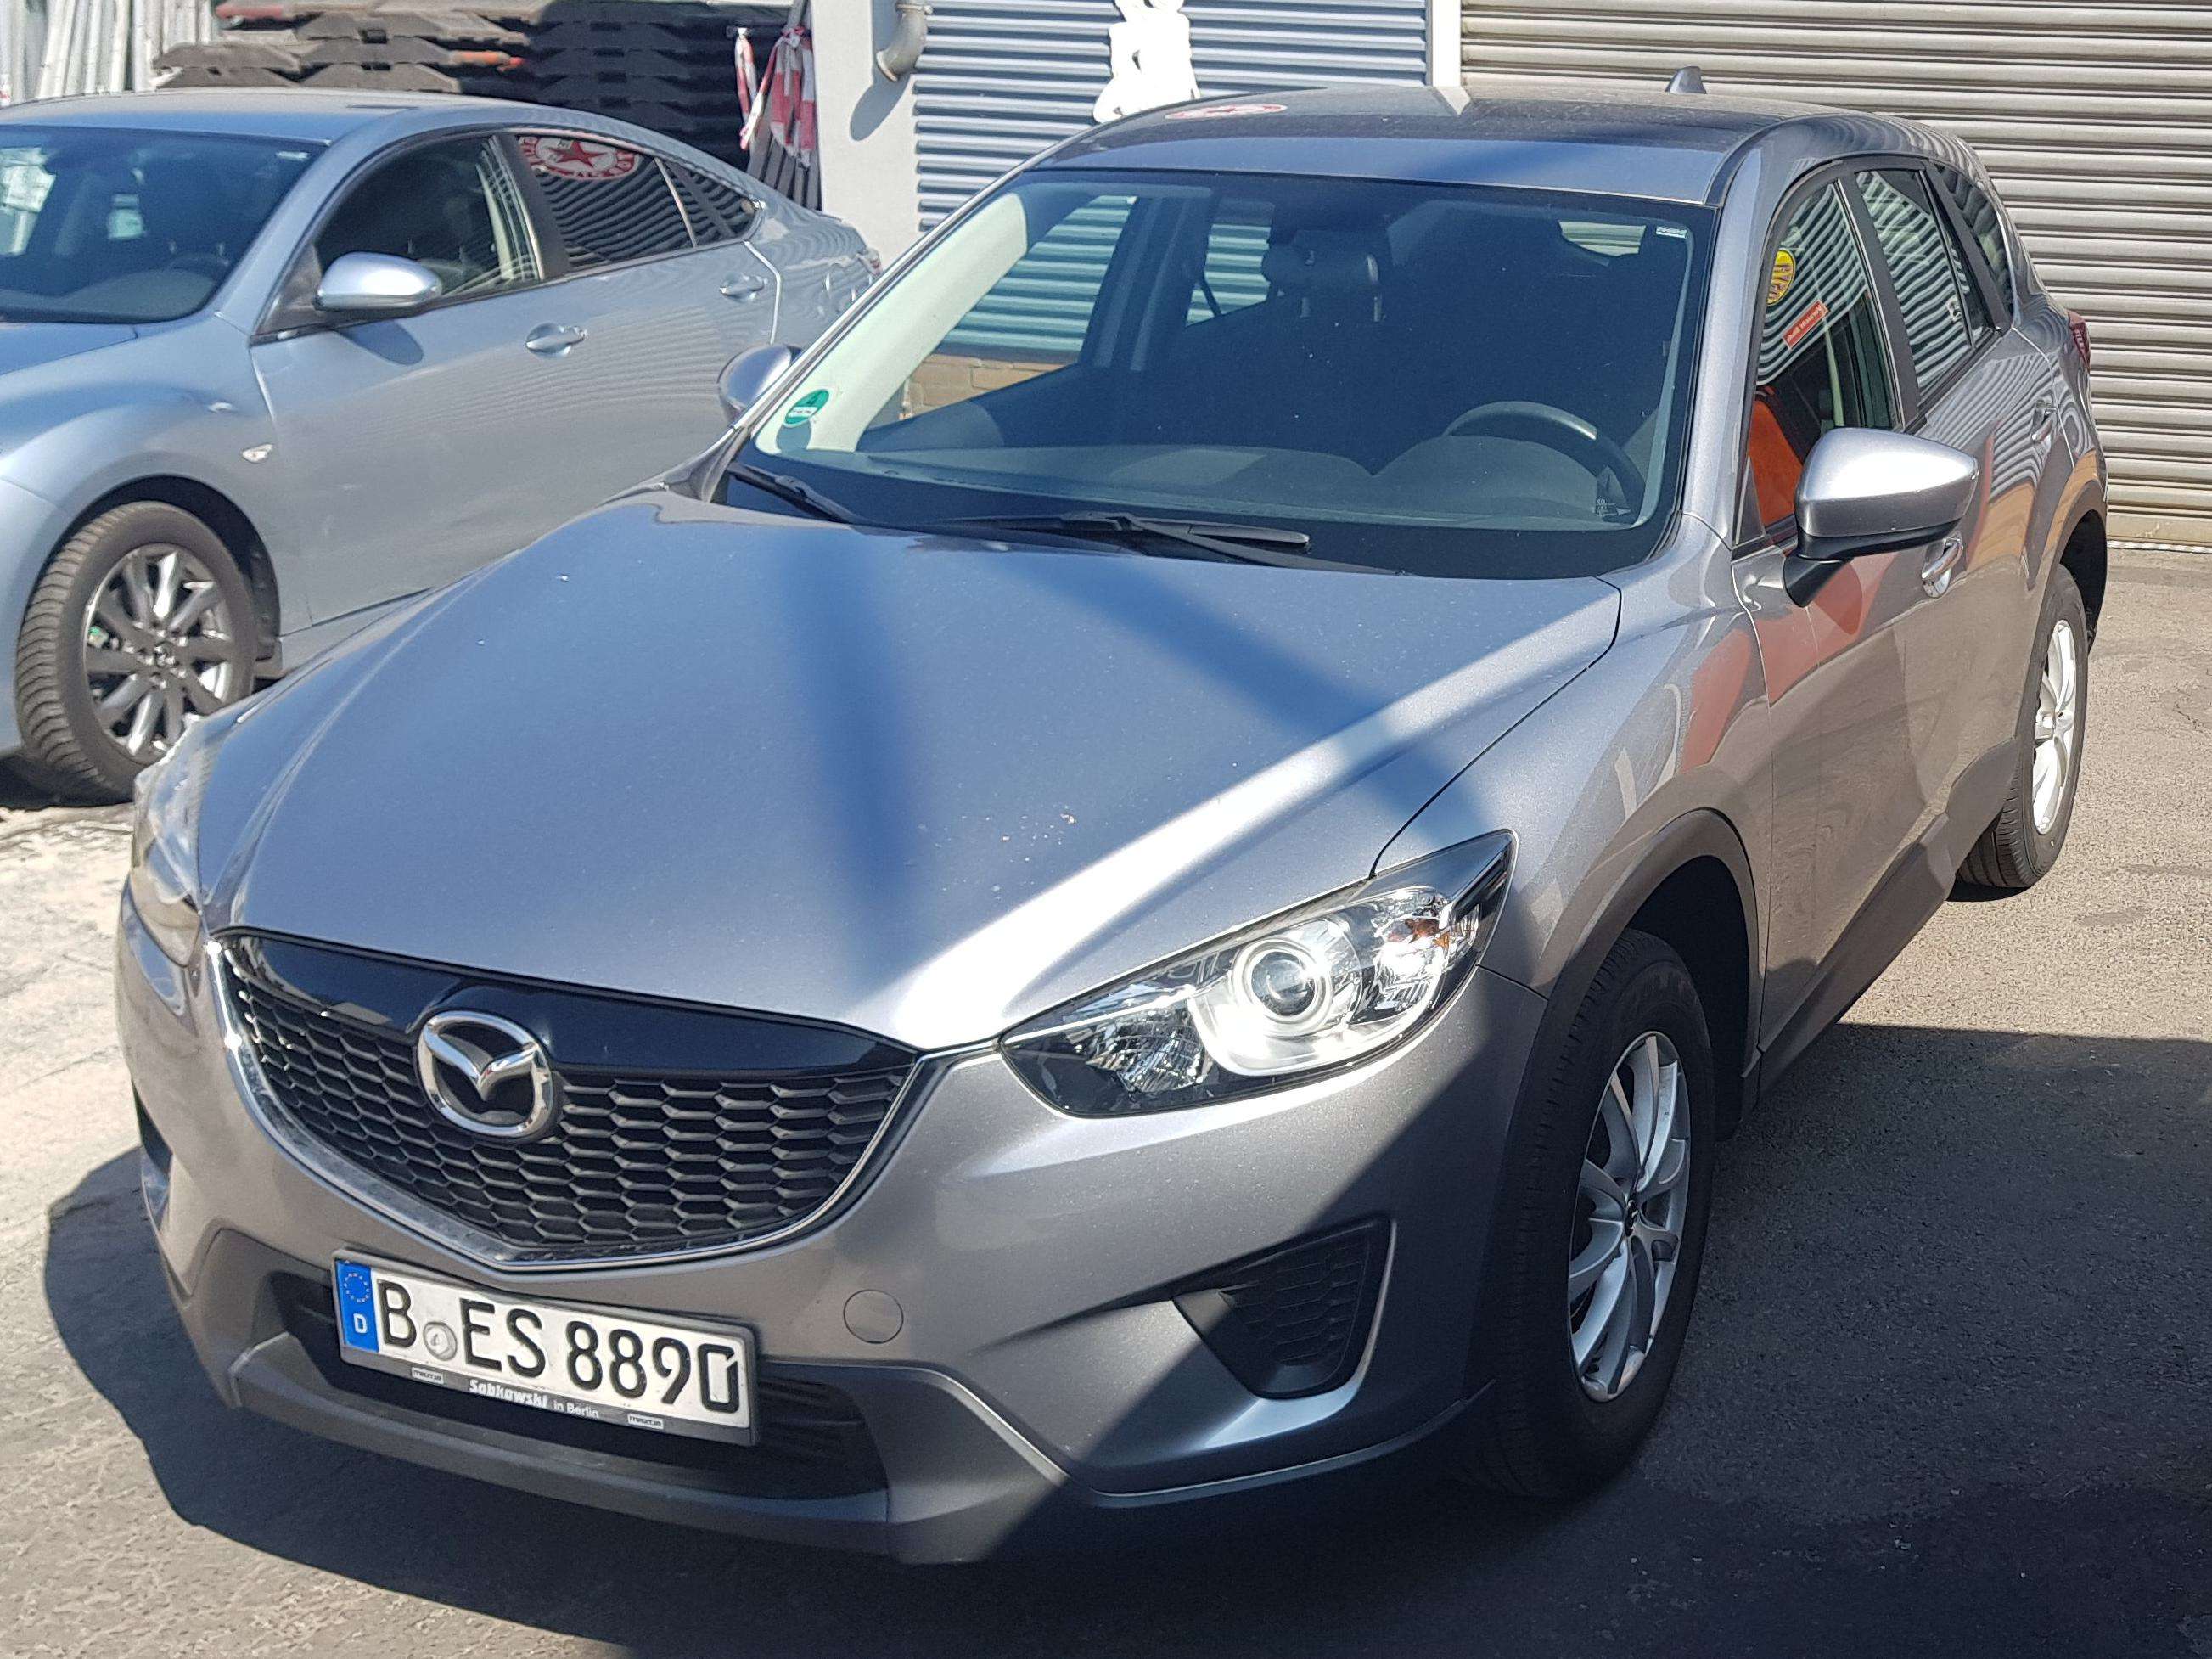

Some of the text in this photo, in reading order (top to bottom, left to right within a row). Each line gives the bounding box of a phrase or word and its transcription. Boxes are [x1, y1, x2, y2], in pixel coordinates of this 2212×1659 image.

[354, 1314, 368, 1334] D
[378, 1279, 739, 1413] B ES 8890
[554, 1401, 564, 1411] in
[567, 1403, 599, 1419] Berlin
